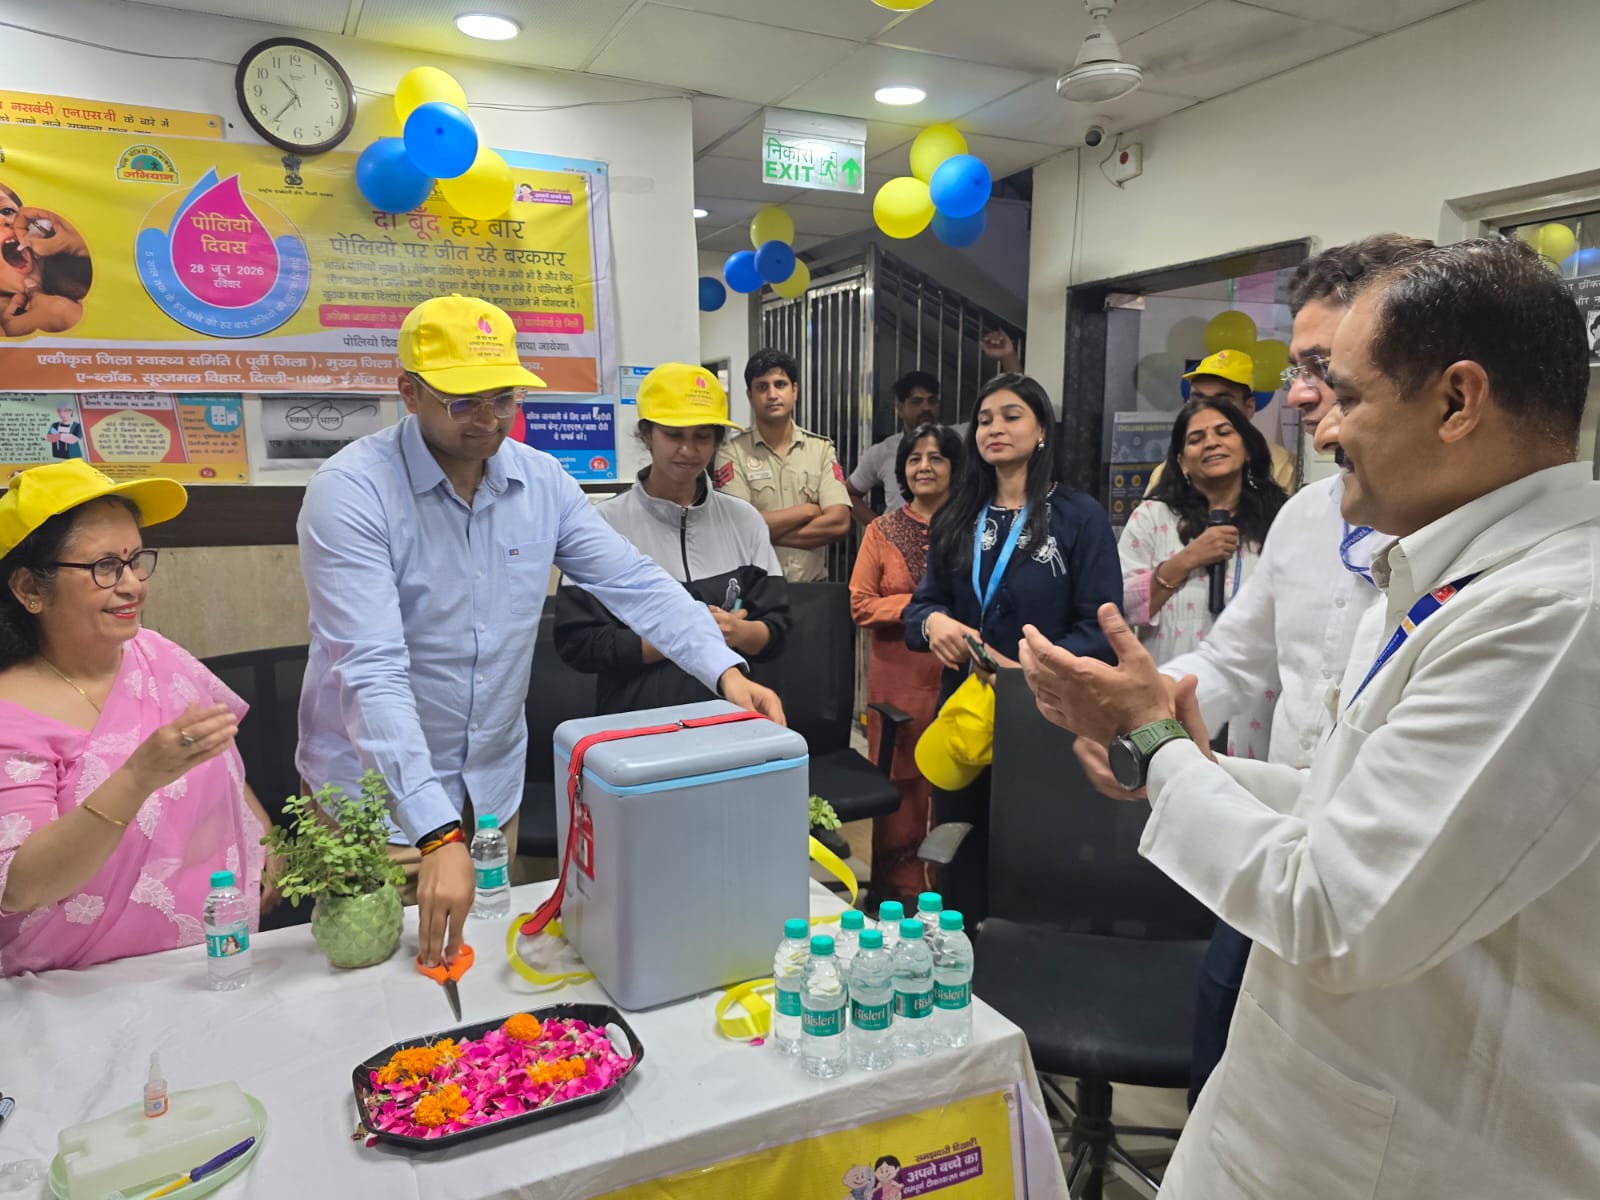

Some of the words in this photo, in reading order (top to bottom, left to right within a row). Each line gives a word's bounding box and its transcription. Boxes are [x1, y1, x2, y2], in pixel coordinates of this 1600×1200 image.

[272, 56, 281, 69] 11
[289, 54, 302, 67] 12
[257, 67, 269, 80] 10
[313, 63, 318, 76] 1
[253, 84, 263, 97] 9
[324, 79, 333, 91] 2
[259, 103, 269, 116] 8
[330, 97, 340, 110] 3
[124, 114, 135, 124] के
[140, 116, 156, 127] बारे
[161, 117, 170, 128] में
[326, 115, 334, 127] 4
[293, 126, 304, 140] 6
[312, 125, 322, 138] 5
[765, 160, 815, 182] EXIT
[191, 211, 253, 234] पोलियो
[448, 216, 480, 237] हर
[486, 218, 526, 240] बार
[201, 234, 247, 255] दिवस
[329, 232, 398, 257] पोलियो
[402, 242, 429, 258] पर
[433, 239, 470, 262] जीत
[474, 241, 497, 264] रहे
[504, 248, 567, 267] बरकरार
[190, 263, 205, 274] 28
[211, 264, 231, 278] जून
[236, 265, 264, 277] 2026
[213, 277, 241, 289] रविवार
[343, 334, 378, 348] पोलियो
[381, 335, 398, 348] दिव
[516, 341, 536, 351] नाया
[37, 352, 92, 369] एकीकृत
[96, 352, 132, 366] जिला
[188, 353, 231, 367] समिति
[246, 354, 270, 371] पूर्वी
[273, 355, 307, 369] जिला
[361, 356, 393, 370] जिला
[142, 371, 201, 387] सूरजमल
[935, 985, 965, 1001] Bisleri
[914, 993, 933, 1011] Bisl
[803, 1013, 836, 1027] Bisleri
[854, 1006, 885, 1021] Bisleri
[906, 1163, 937, 1183] अपने
[939, 1155, 962, 1173] बच्चे
[963, 1151, 979, 1166] का
